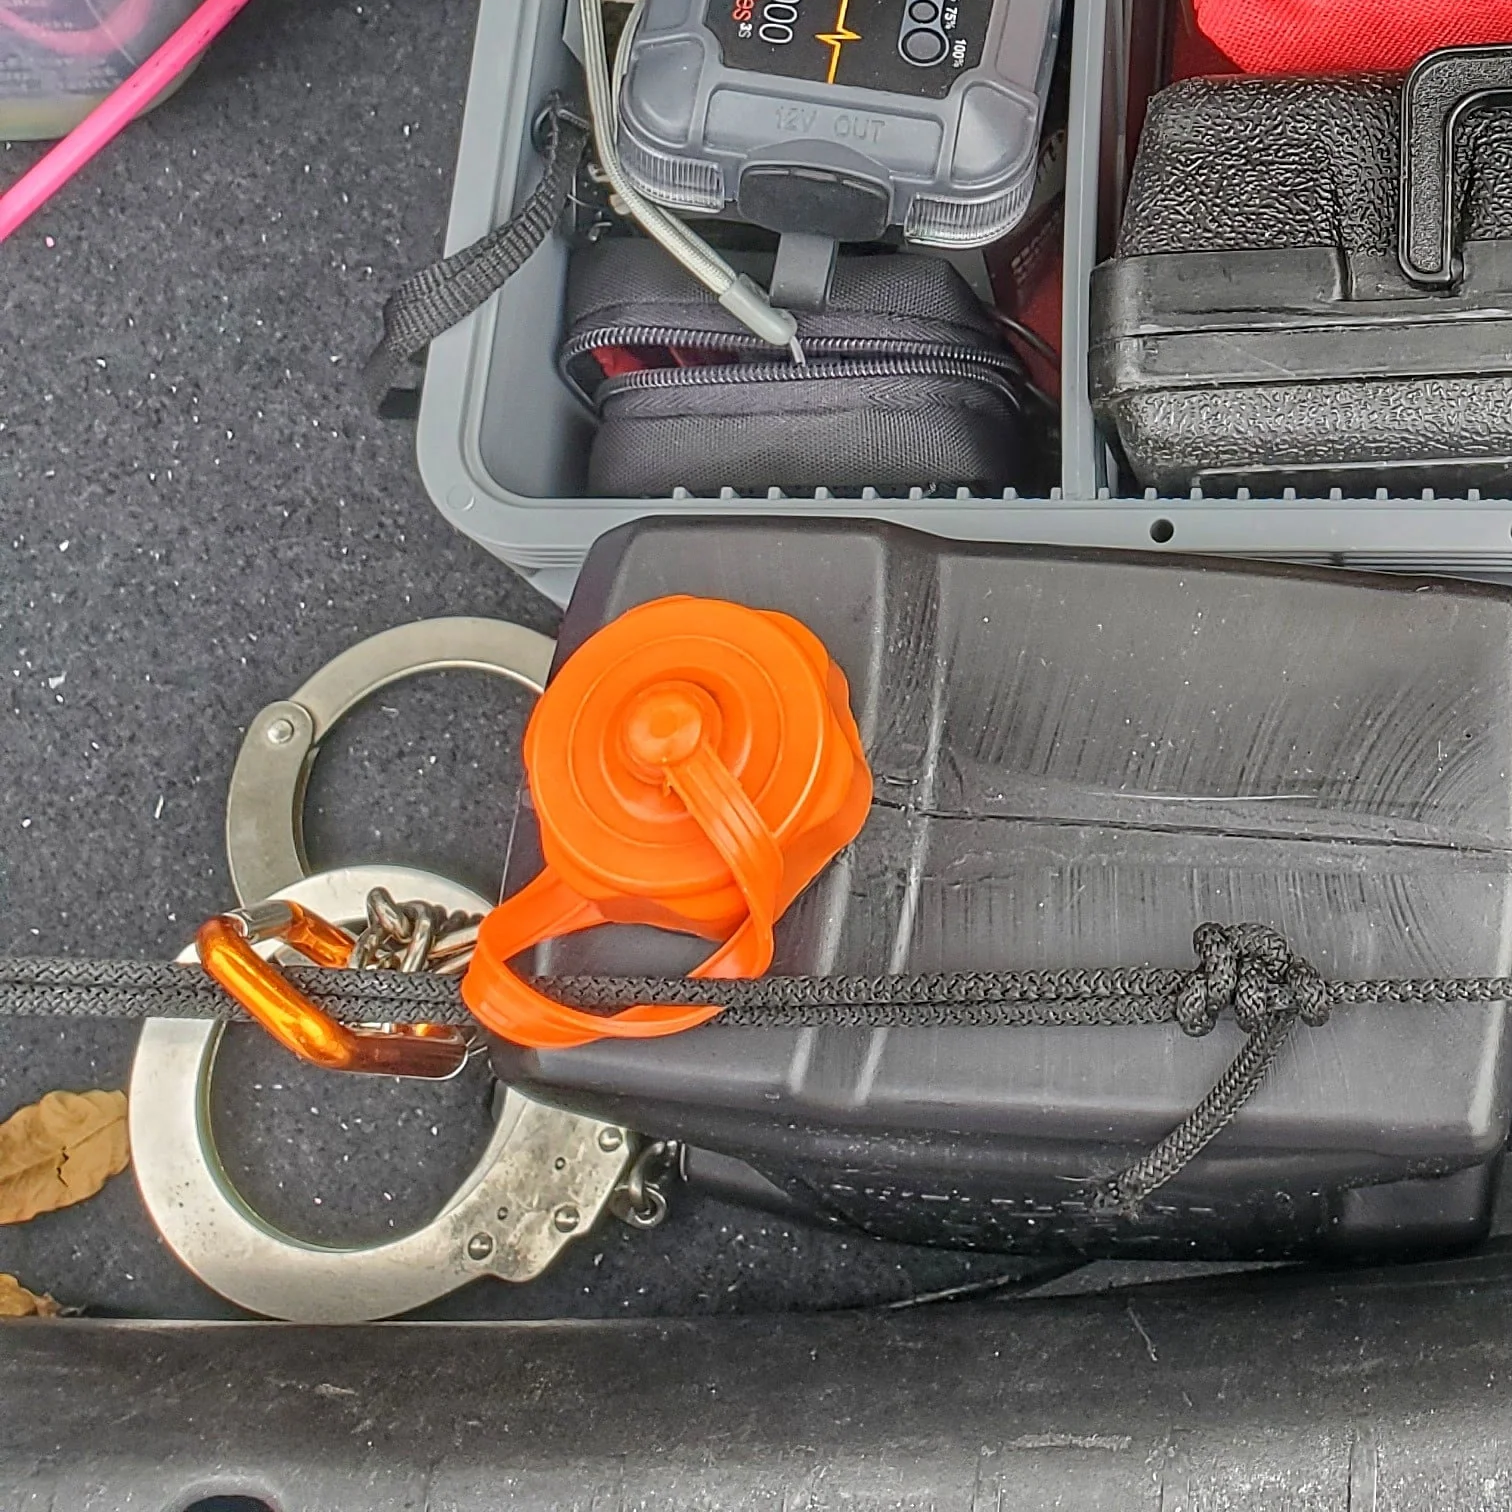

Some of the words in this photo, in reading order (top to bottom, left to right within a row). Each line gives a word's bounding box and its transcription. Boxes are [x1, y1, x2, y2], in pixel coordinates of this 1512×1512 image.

[944, 7, 958, 30] 75%
[952, 39, 967, 69] 100%
[775, 106, 818, 133] 12V
[833, 115, 886, 144] OUT
